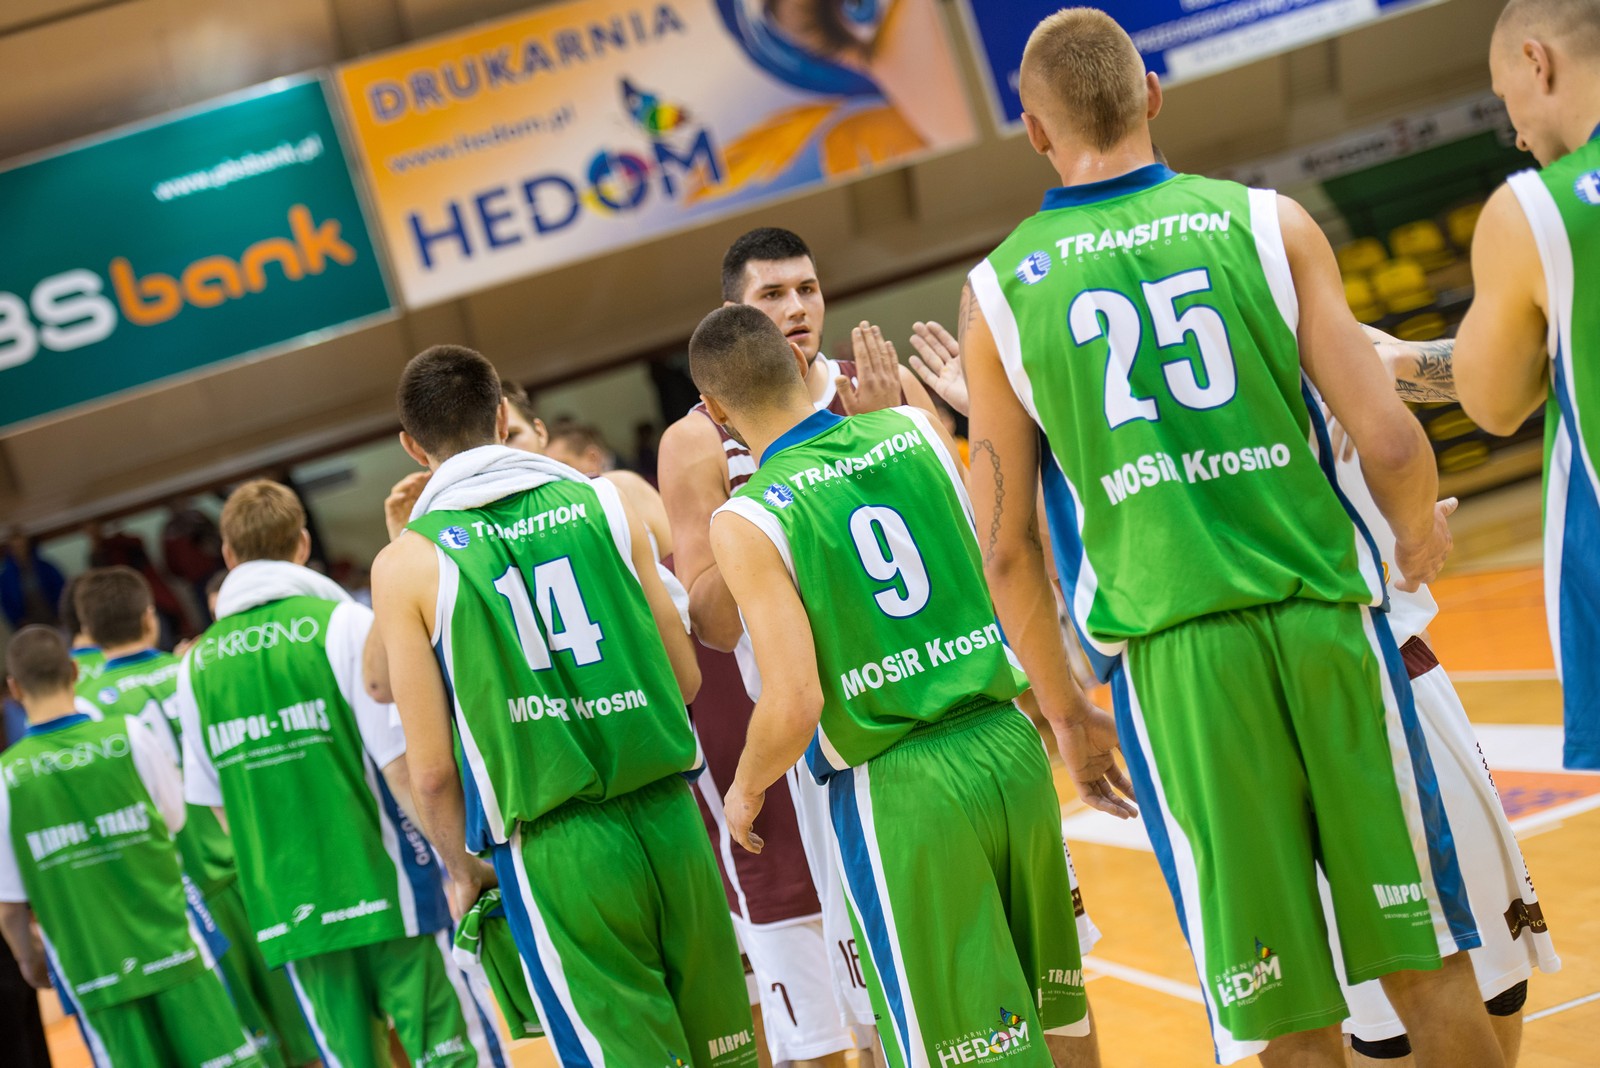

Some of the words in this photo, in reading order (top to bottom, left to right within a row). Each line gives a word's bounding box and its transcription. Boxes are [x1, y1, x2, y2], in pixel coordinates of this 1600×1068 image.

[368, 2, 684, 122] DRUKARNIA
[407, 127, 725, 270] HEDOM
[1055, 210, 1231, 260] TRANSITION
[1067, 266, 1238, 431] 25
[789, 429, 923, 490] TRANSITION
[1100, 451, 1182, 506] MOSiR
[1181, 442, 1291, 484] Krosno
[848, 503, 932, 619] 9
[492, 554, 606, 673] 14
[840, 647, 925, 700] MOSiR
[924, 622, 1002, 668] Krosn
[507, 694, 570, 723] MOSR
[571, 689, 648, 720] Krosno
[708, 1029, 752, 1060] MARPOL
[935, 1027, 995, 1050] DRUKARNIA
[937, 1021, 1030, 1068] HEDOM
